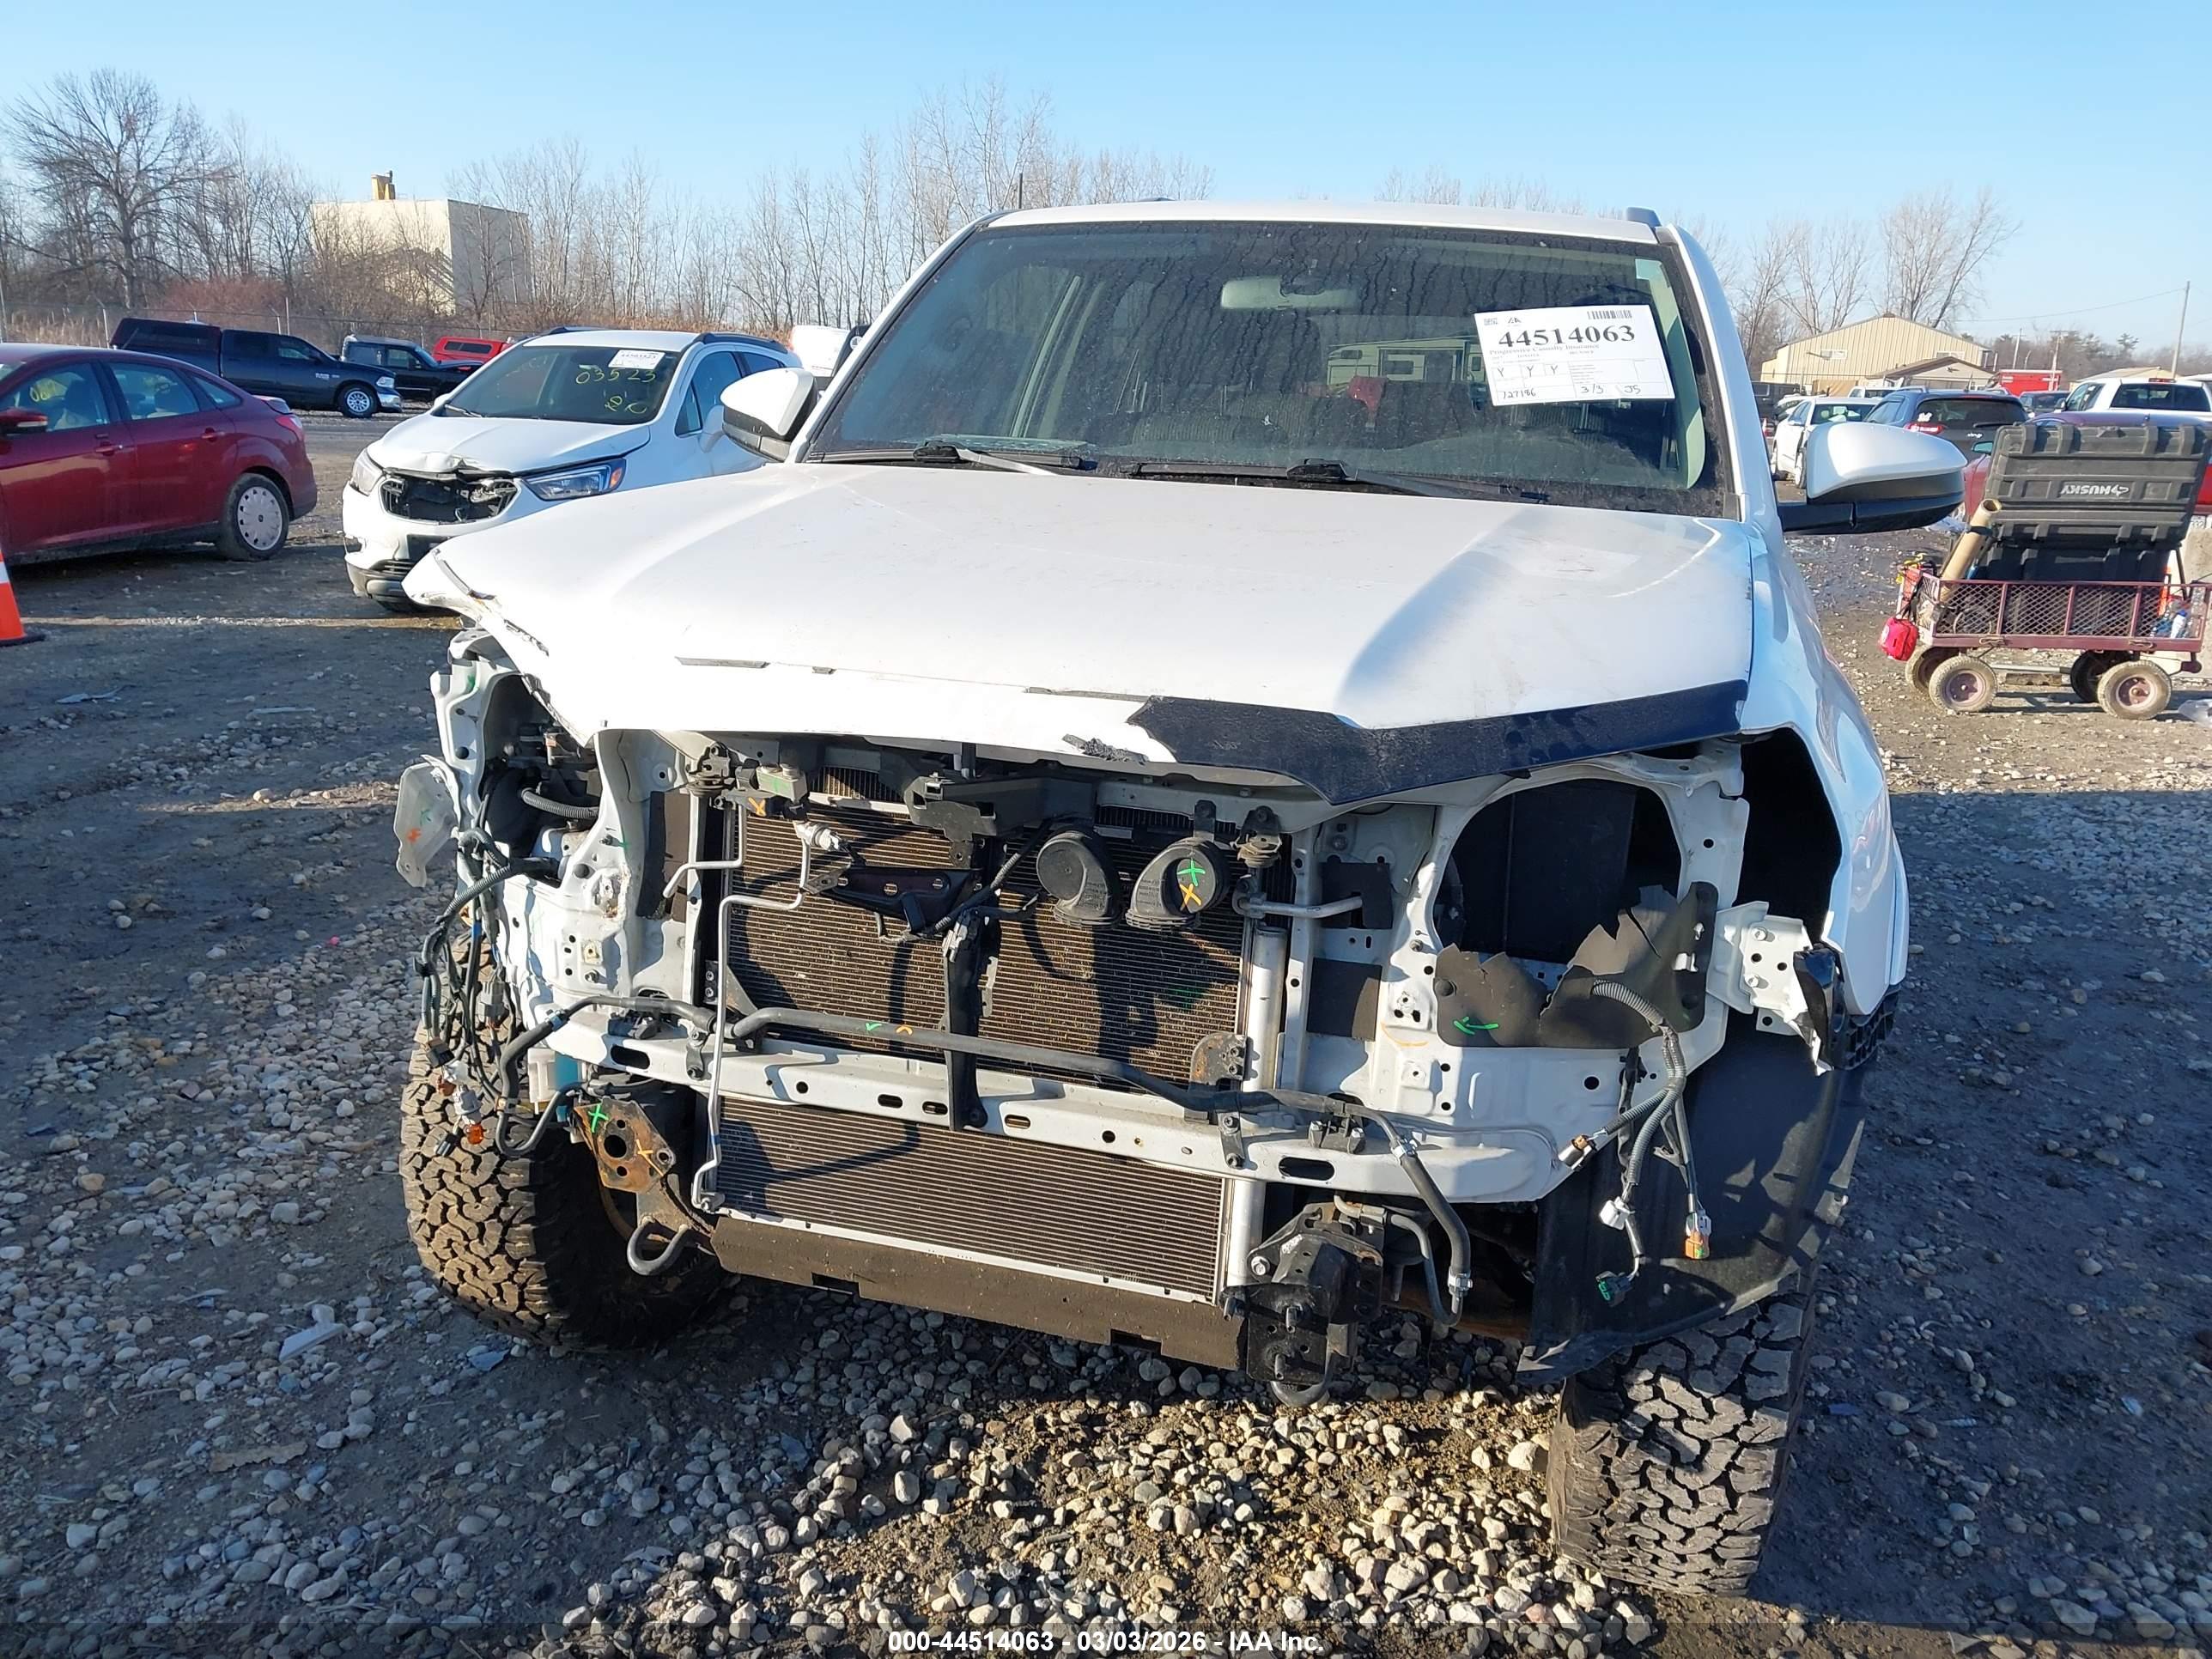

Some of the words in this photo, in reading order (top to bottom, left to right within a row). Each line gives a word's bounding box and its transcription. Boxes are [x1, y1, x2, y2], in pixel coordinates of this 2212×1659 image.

[1498, 325, 1635, 348] 44514063
[575, 368, 657, 385] 03523
[1526, 366, 1534, 377] Y
[1550, 364, 1559, 375] Y
[1580, 384, 1604, 394] 3/3
[2060, 484, 2112, 495] HUSKY
